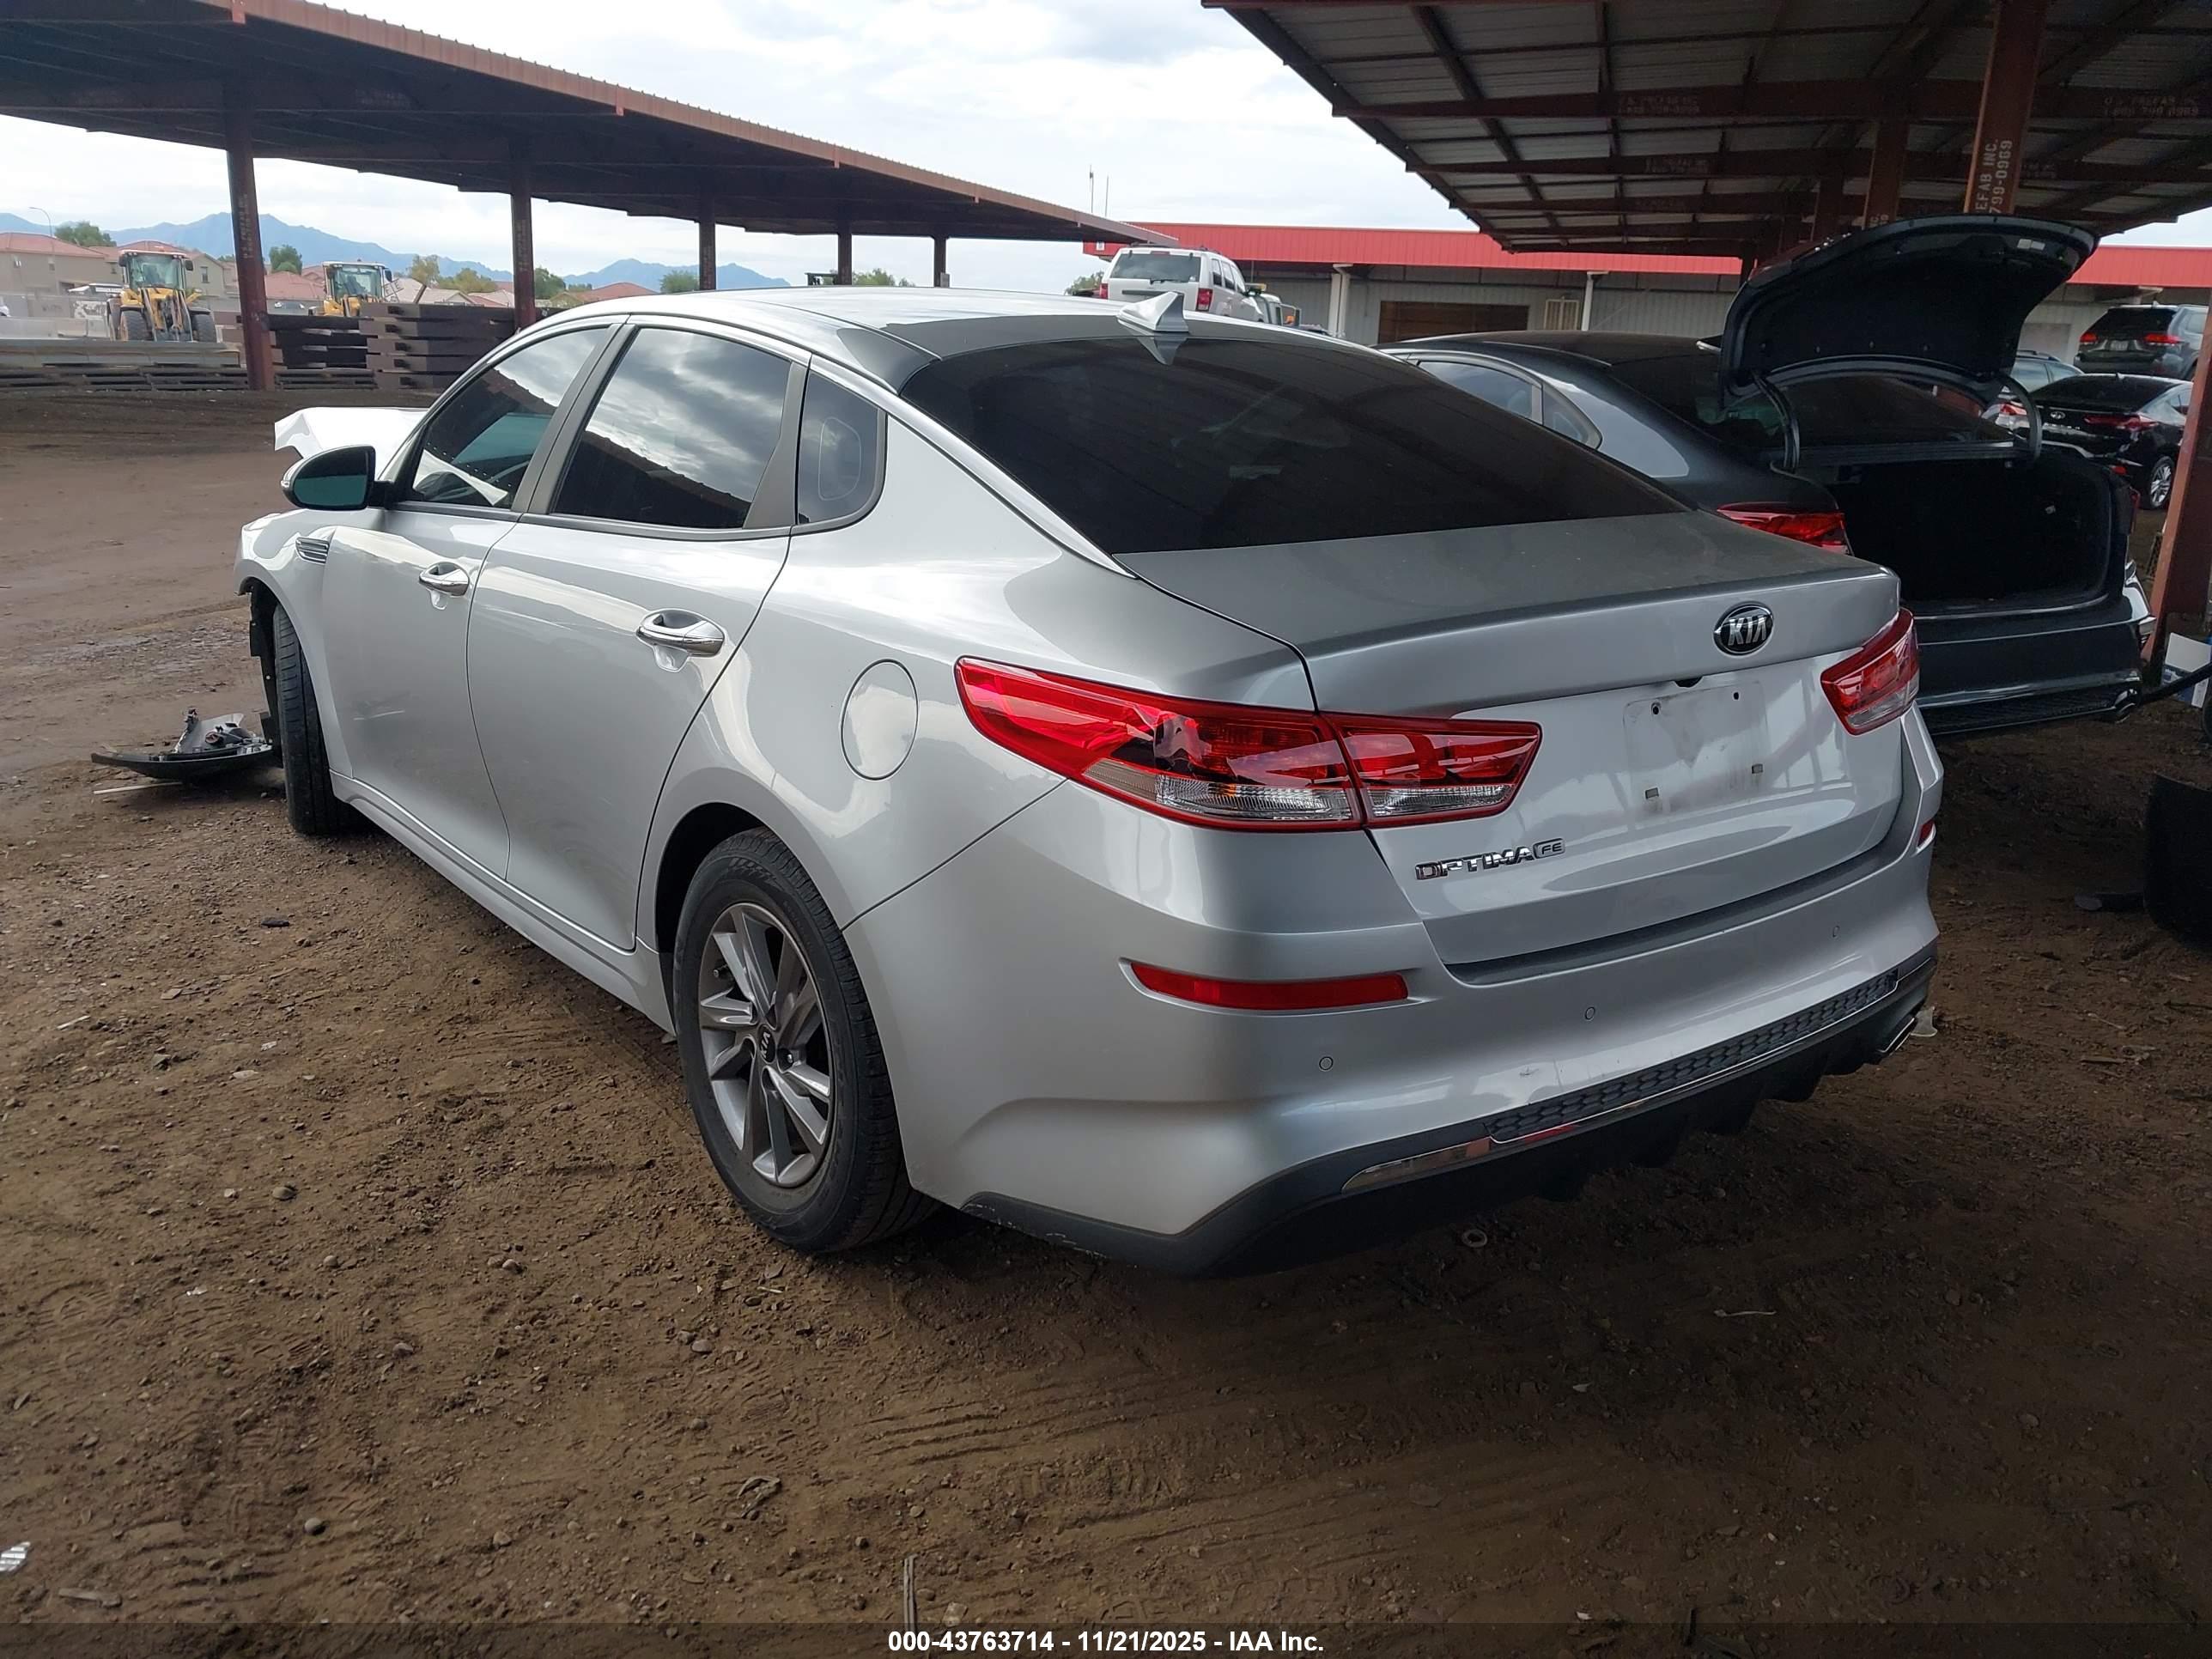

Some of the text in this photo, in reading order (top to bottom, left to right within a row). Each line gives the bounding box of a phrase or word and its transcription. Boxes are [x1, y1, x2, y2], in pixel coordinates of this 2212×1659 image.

[1983, 139, 1998, 167] INC.
[1727, 616, 1768, 647] KIA
[1415, 846, 1534, 880] OPTIMA
[761, 1031, 771, 1059] KIA
